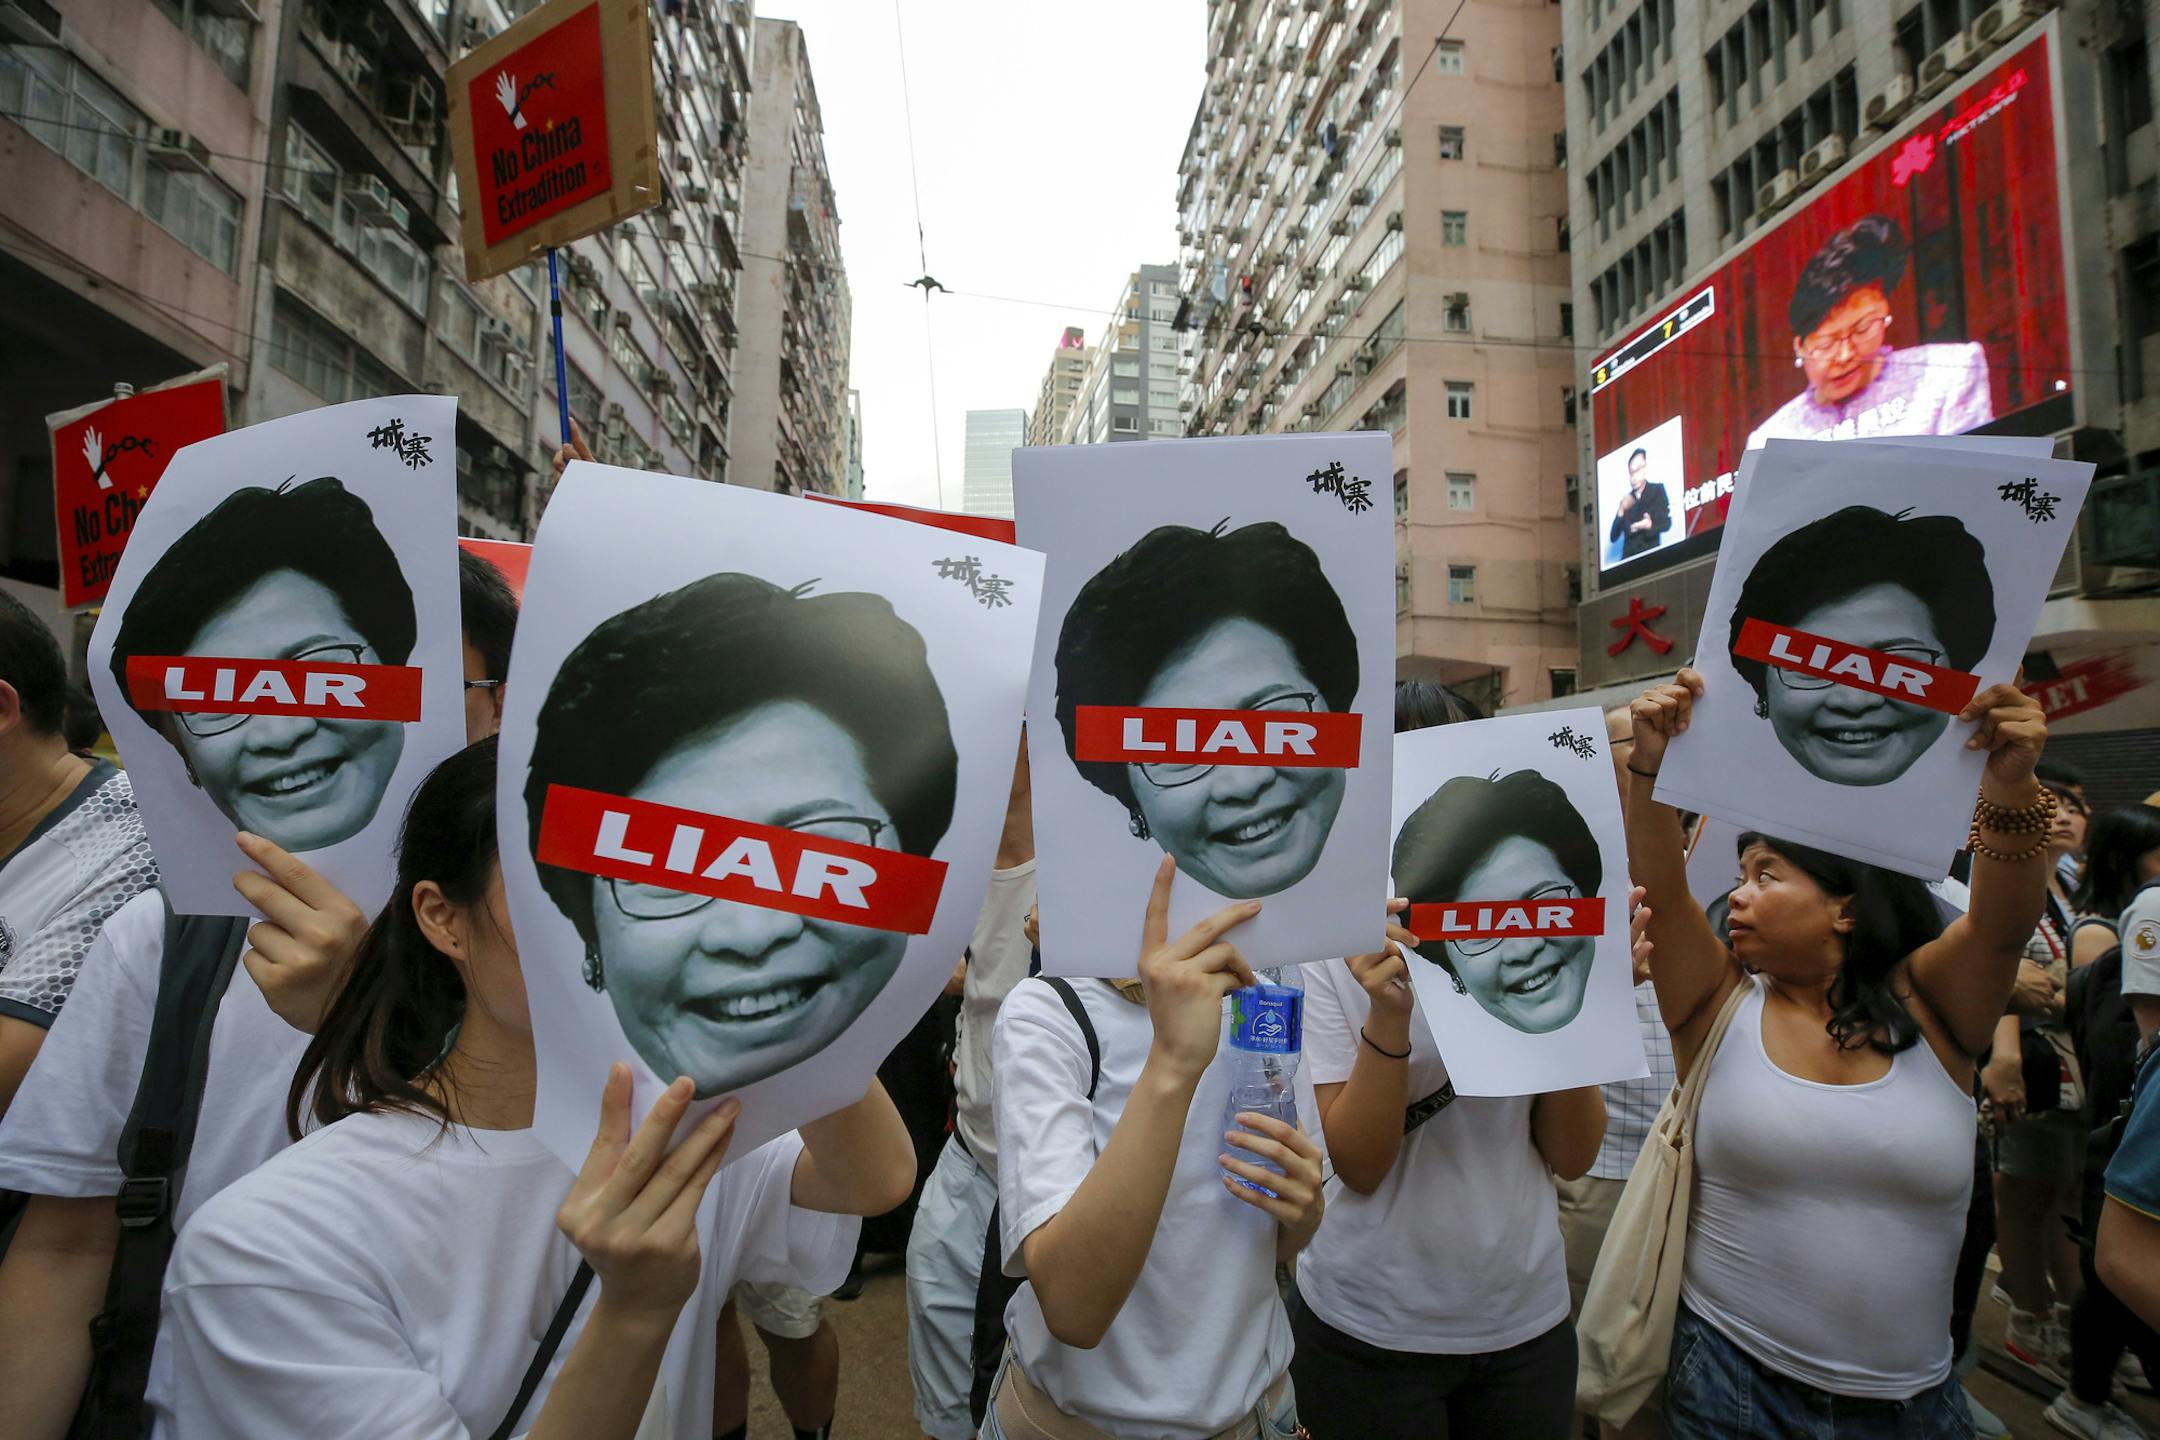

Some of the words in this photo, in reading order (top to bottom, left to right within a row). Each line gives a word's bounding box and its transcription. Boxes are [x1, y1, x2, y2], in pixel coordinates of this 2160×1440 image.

[490, 147, 519, 189] No
[520, 115, 583, 172] China
[497, 160, 587, 225] Extradition
[366, 417, 434, 471] 城寨
[1305, 461, 1374, 516] 城寨
[1996, 477, 2062, 525] 城寨
[73, 505, 100, 548] No
[931, 555, 1015, 610] 城寨
[1607, 596, 1675, 657] 大
[163, 666, 367, 708] LIAR
[1768, 633, 1935, 698] LIAR
[1122, 718, 1318, 755] LIAR
[593, 810, 878, 910] LIAR
[1441, 906, 1575, 932] LIAR
